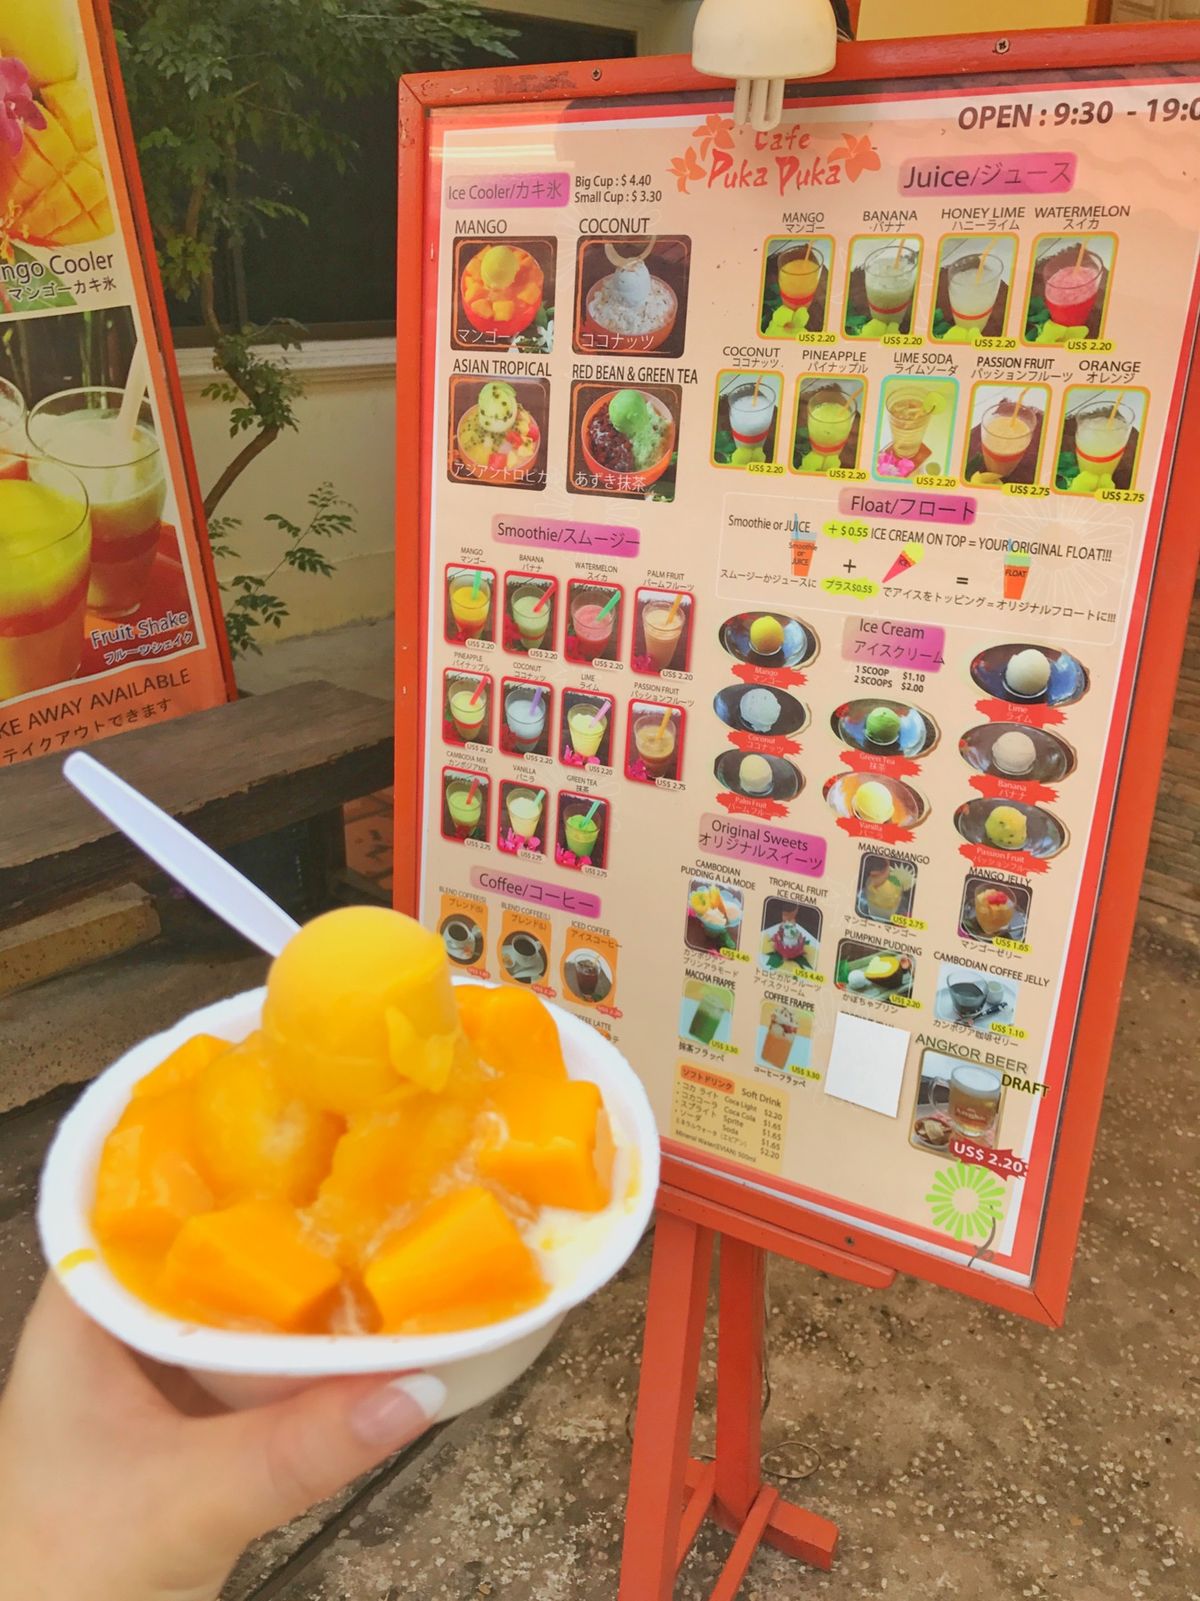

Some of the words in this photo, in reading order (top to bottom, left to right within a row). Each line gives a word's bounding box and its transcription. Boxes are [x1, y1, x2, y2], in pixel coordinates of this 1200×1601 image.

[958, 104, 1032, 130] OPEN
[1054, 100, 1114, 126] 9:30
[707, 149, 768, 188] Puka
[776, 156, 840, 197] Puka
[904, 162, 1072, 188] Juice/ジュース
[449, 185, 467, 200] Ice
[469, 180, 563, 200] Cooler/カキ氷
[575, 176, 591, 189] Big
[593, 176, 613, 189] Cup
[575, 191, 601, 204] Small
[603, 191, 623, 204] Cup
[782, 212, 824, 223] MANGO
[863, 210, 918, 221] BANANA
[942, 208, 990, 220] HONEY
[992, 207, 1025, 218] LIME
[1034, 206, 1130, 218] WATERMELON
[455, 219, 507, 234] MANGO
[579, 218, 650, 233] COCONUT
[785, 223, 825, 232] マンゴー
[871, 222, 905, 232] バナナ
[952, 219, 1020, 231] ハニーライム
[1064, 218, 1100, 230] スイカ
[1, 260, 44, 285] ngo
[49, 251, 114, 276] Cooler
[9, 276, 117, 301] マンゴーカキ氷
[457, 329, 511, 343] マンゴー
[581, 333, 654, 349] ココナッツ
[974, 338, 991, 348] US$
[994, 339, 1016, 348] 2.20
[723, 346, 781, 357] COCONUT
[1068, 341, 1086, 350] US$
[1089, 341, 1112, 351] 2.20
[733, 357, 779, 368] ココナッツ
[802, 350, 866, 362] PINEAPPLE
[894, 352, 918, 364] LIME
[922, 353, 953, 365] SODA
[977, 356, 1022, 369] PASSION
[1024, 358, 1054, 370] FRUIT
[453, 360, 489, 373] ASIAN
[492, 361, 552, 377] TROPICAL
[573, 364, 593, 379] RED
[596, 366, 625, 381] BEAN
[627, 368, 635, 381] &
[638, 366, 674, 383] GREEN
[677, 368, 698, 384] TEA
[807, 362, 868, 374] パイナップル
[894, 363, 958, 376] ライムソーダ
[1078, 360, 1141, 373] ORANGE
[971, 369, 1073, 382] パッションフルーツ
[1086, 372, 1134, 384] オレンジ
[575, 471, 646, 492] あずき抹茶
[917, 477, 934, 486] US$
[937, 478, 956, 487] 2.20
[1010, 485, 1029, 494] US$
[1032, 486, 1050, 496] 2.75
[1102, 491, 1121, 501] US$
[1124, 492, 1144, 503] 2.75
[851, 495, 975, 525] Float/フロート
[498, 522, 640, 549] Smoothie/スムージー
[728, 514, 771, 530] Smoothie
[773, 520, 783, 530] or
[784, 520, 810, 533] JUICE
[871, 528, 886, 540] ICE
[889, 529, 924, 544] CREAM
[926, 532, 943, 545] ON
[946, 535, 964, 548] TOP
[978, 537, 1009, 551] YOUR
[1011, 540, 1063, 557] ORIGINAL
[1066, 546, 1112, 563] FLOAT!!!
[461, 547, 483, 556] MANGO
[519, 554, 544, 563] BANANA
[575, 562, 618, 573] WATERMELON
[647, 570, 665, 579] PALM
[666, 572, 685, 580] FRUIT
[1005, 570, 1027, 578] FLOAT
[90, 626, 134, 649] Fruit
[138, 611, 189, 638] Shake
[860, 618, 877, 634] Ice
[882, 621, 925, 640] Cream
[104, 631, 193, 665] フルーツシェイク
[854, 640, 945, 665] アイスクリーム
[513, 662, 542, 672] COCONUT
[856, 665, 860, 674] 1
[862, 666, 889, 677] SCOOP
[903, 672, 925, 682] $1.10
[581, 673, 595, 682] LIME
[854, 675, 859, 683] 2
[860, 677, 892, 689] SCOOPS
[901, 681, 923, 693] $2.00
[634, 681, 660, 693] PASSION
[661, 685, 679, 696] FRUIT
[28, 697, 83, 730] AWAY
[90, 668, 191, 710] AVAILABLE
[2, 697, 172, 764] テイクアウトできます
[513, 764, 536, 775] VANILLA
[567, 774, 584, 785] GREEN
[584, 777, 597, 787] TEA
[711, 819, 760, 840] Original
[763, 831, 808, 851] Sweets
[699, 833, 823, 871] オリジナルスイーツ
[858, 842, 930, 865] MANGO&MANGO
[695, 859, 741, 876] CAMBODIAN
[681, 865, 714, 880] PUDDING
[715, 873, 721, 881] A
[722, 875, 731, 883] LA
[733, 877, 756, 891] MODE
[969, 867, 1004, 882] MANGO
[1006, 874, 1032, 888] JELLY
[479, 873, 594, 910] Coffee/コーヒー
[769, 876, 804, 893] TROPICAL
[806, 886, 828, 898] FRUIT
[777, 889, 789, 898] ICE
[790, 892, 817, 905] CREAM
[571, 920, 587, 930] ICED
[588, 923, 610, 936] COFFEE
[844, 929, 882, 946] PUMPKIN
[883, 939, 922, 956] PUDDING
[933, 951, 988, 972] CAMBODIAN
[989, 965, 1023, 982] COFFEE
[1024, 973, 1050, 988] JELLY
[712, 974, 736, 990] FRAPPE
[764, 991, 788, 1005] COFFEE
[789, 998, 815, 1012] FRAPPE
[915, 1033, 981, 1061] ANGKOR
[984, 1053, 1028, 1075] BEER
[1001, 1074, 1050, 1098] DRAFT
[741, 1088, 758, 1100] Soft
[759, 1094, 781, 1107] Drink
[954, 1142, 984, 1161] US$
[988, 1154, 1023, 1173] 2.20
